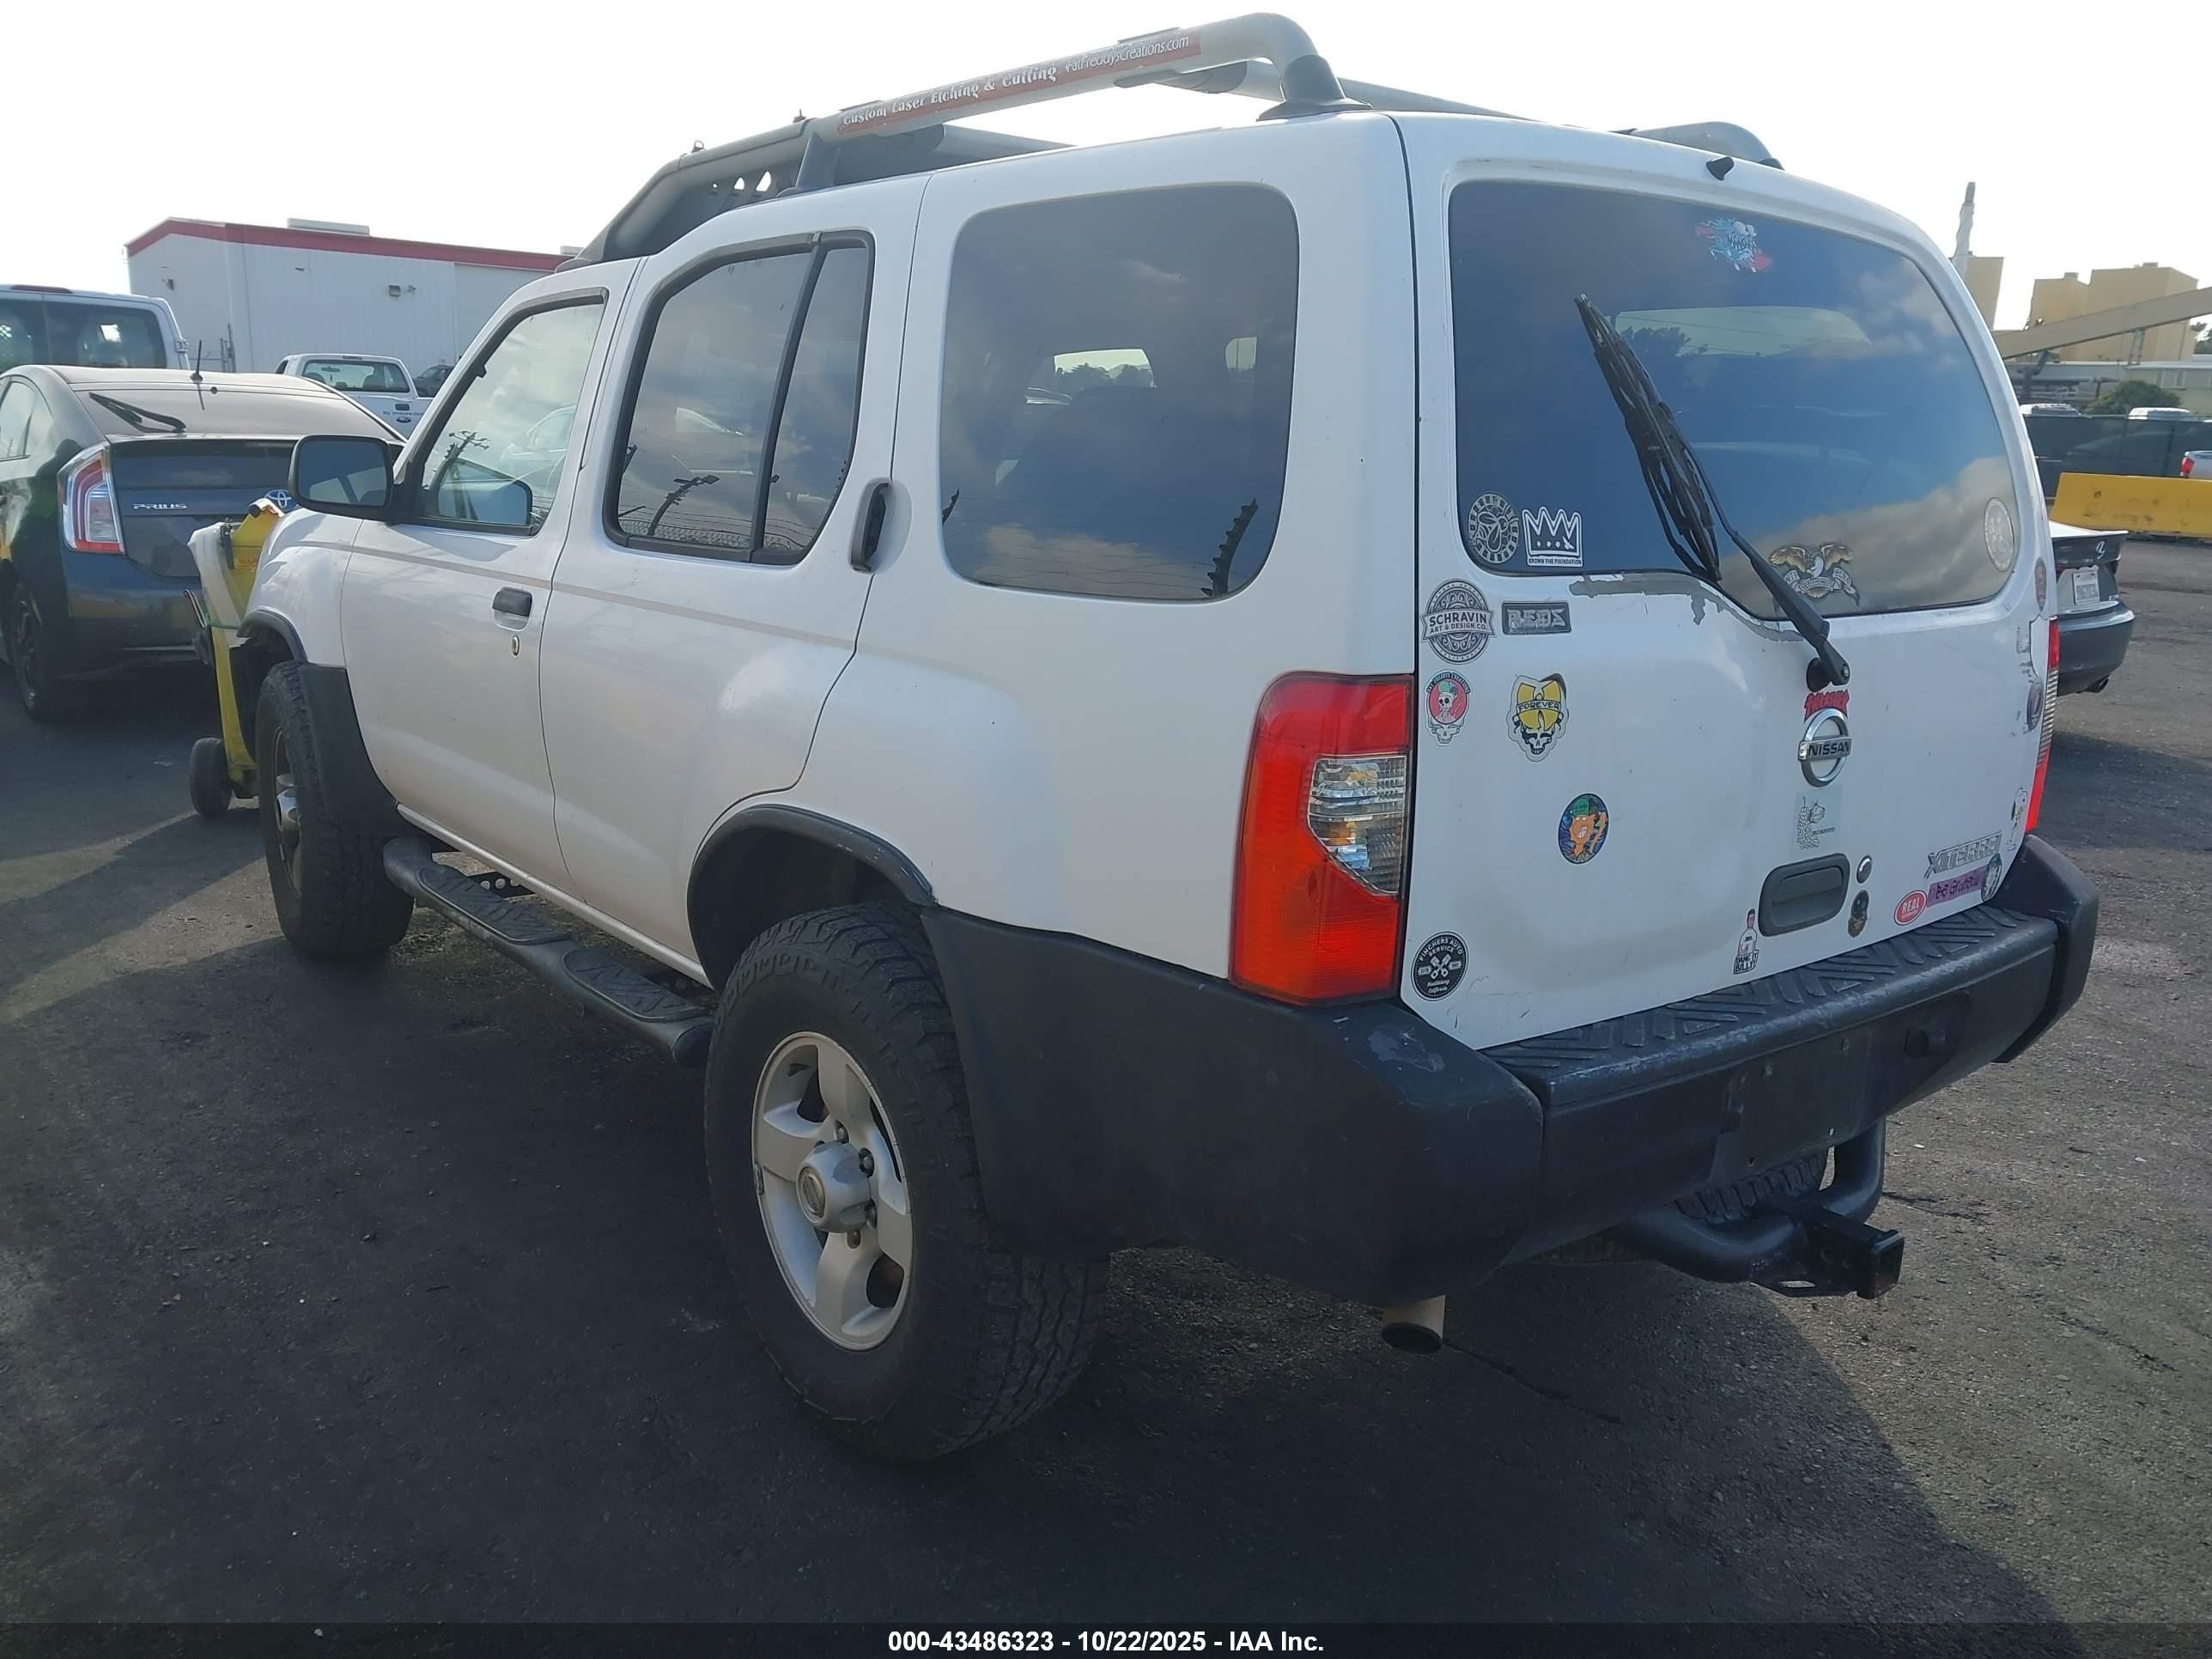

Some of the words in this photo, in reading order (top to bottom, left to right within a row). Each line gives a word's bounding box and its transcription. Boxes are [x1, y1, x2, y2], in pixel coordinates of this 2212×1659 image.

[843, 108, 887, 125] Custom
[892, 98, 924, 113] Laser
[931, 85, 980, 104] Etching
[983, 80, 995, 91] &
[1002, 67, 1057, 87] Cutting
[1429, 611, 1487, 627] SCHRAVIN
[1430, 625, 1443, 634] ART
[1518, 702, 1559, 713] FOREVER
[1808, 741, 1850, 757] NISSAN
[1901, 897, 1920, 915] REAL
[1428, 945, 1455, 957] SERVICE
[1449, 940, 1464, 955] AUTO
